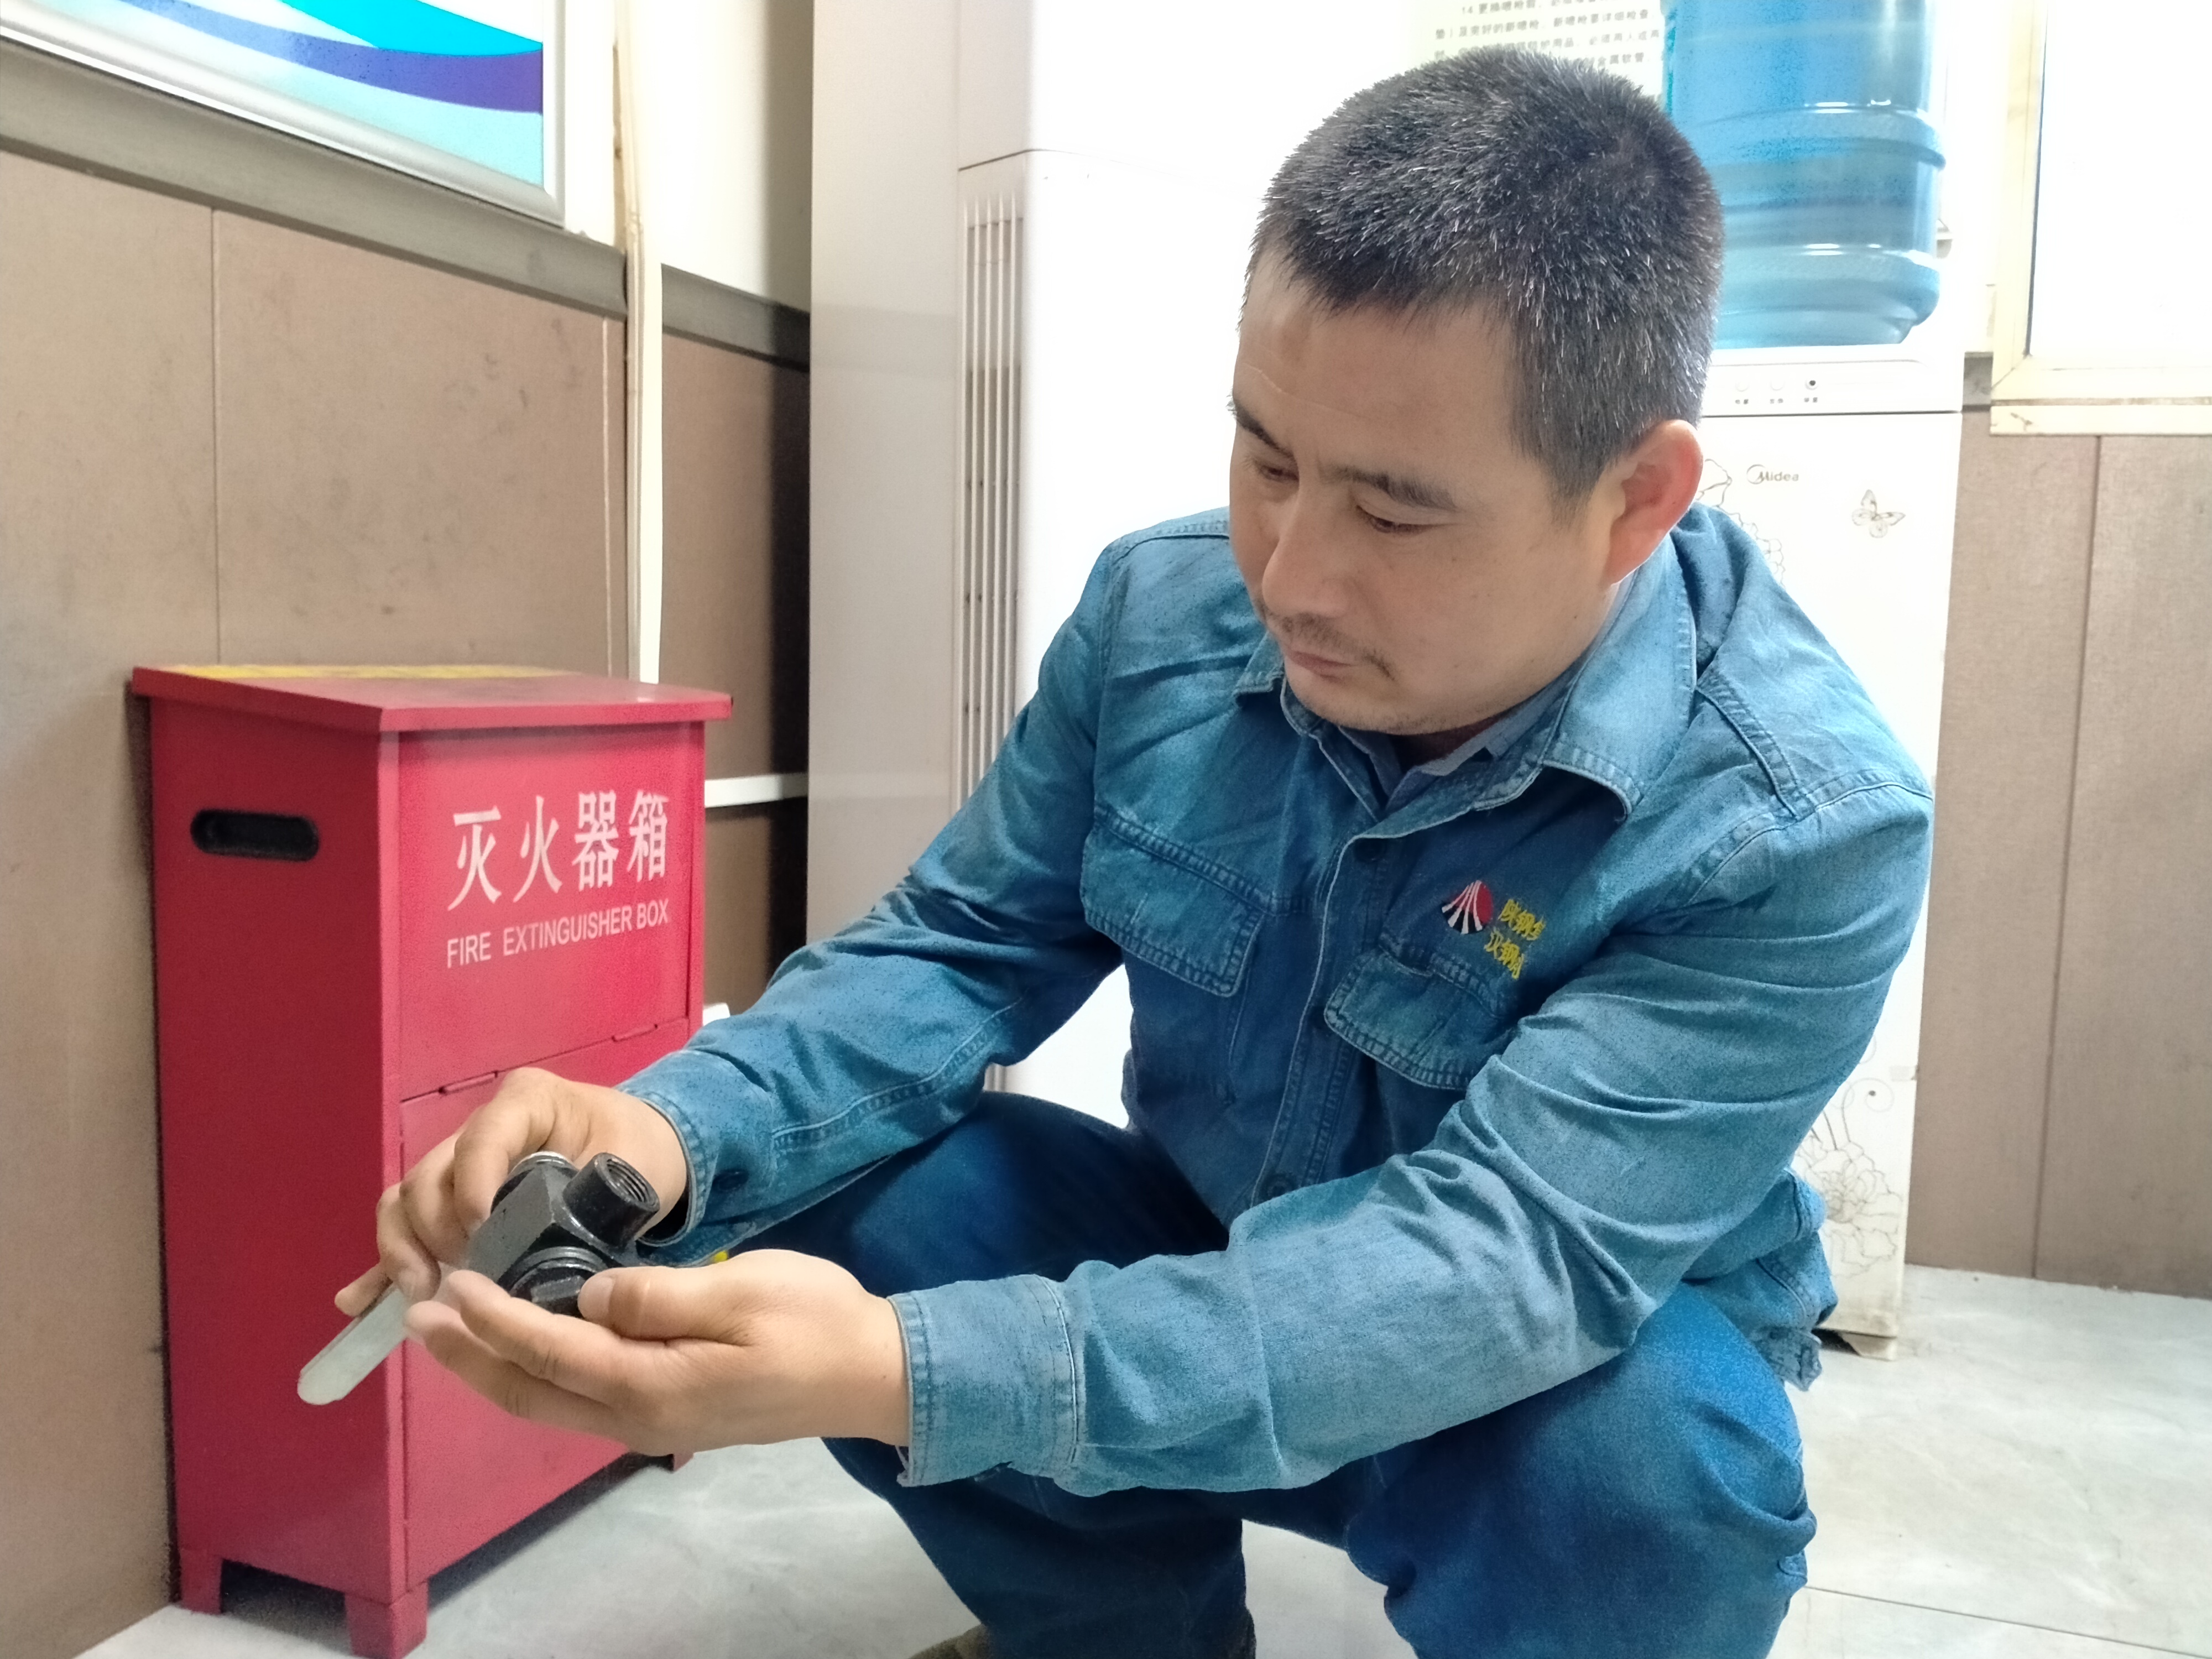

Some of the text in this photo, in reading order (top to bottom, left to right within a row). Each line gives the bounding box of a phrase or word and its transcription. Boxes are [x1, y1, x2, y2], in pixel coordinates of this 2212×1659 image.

[447, 790, 669, 911] 灭火器箱
[447, 899, 669, 968] FIRE EXTINGUISHER BOX
